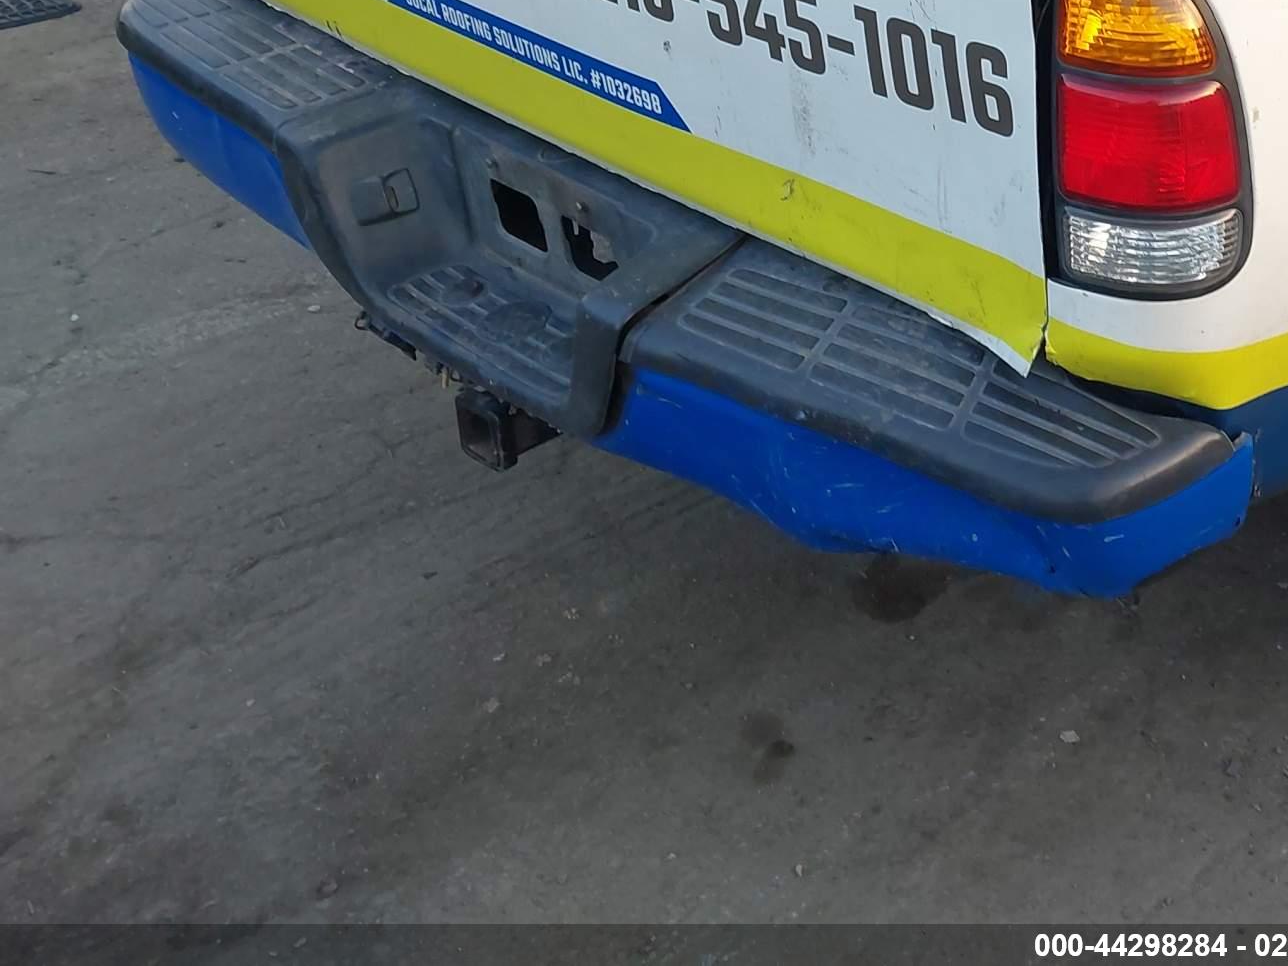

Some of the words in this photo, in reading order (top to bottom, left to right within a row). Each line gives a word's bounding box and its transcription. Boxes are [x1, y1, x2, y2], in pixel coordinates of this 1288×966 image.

[442, 6, 492, 42] ROOFING
[494, 25, 560, 71] SOLUTIONS
[562, 58, 588, 85] LIC.
[590, 68, 662, 115] #1032698
